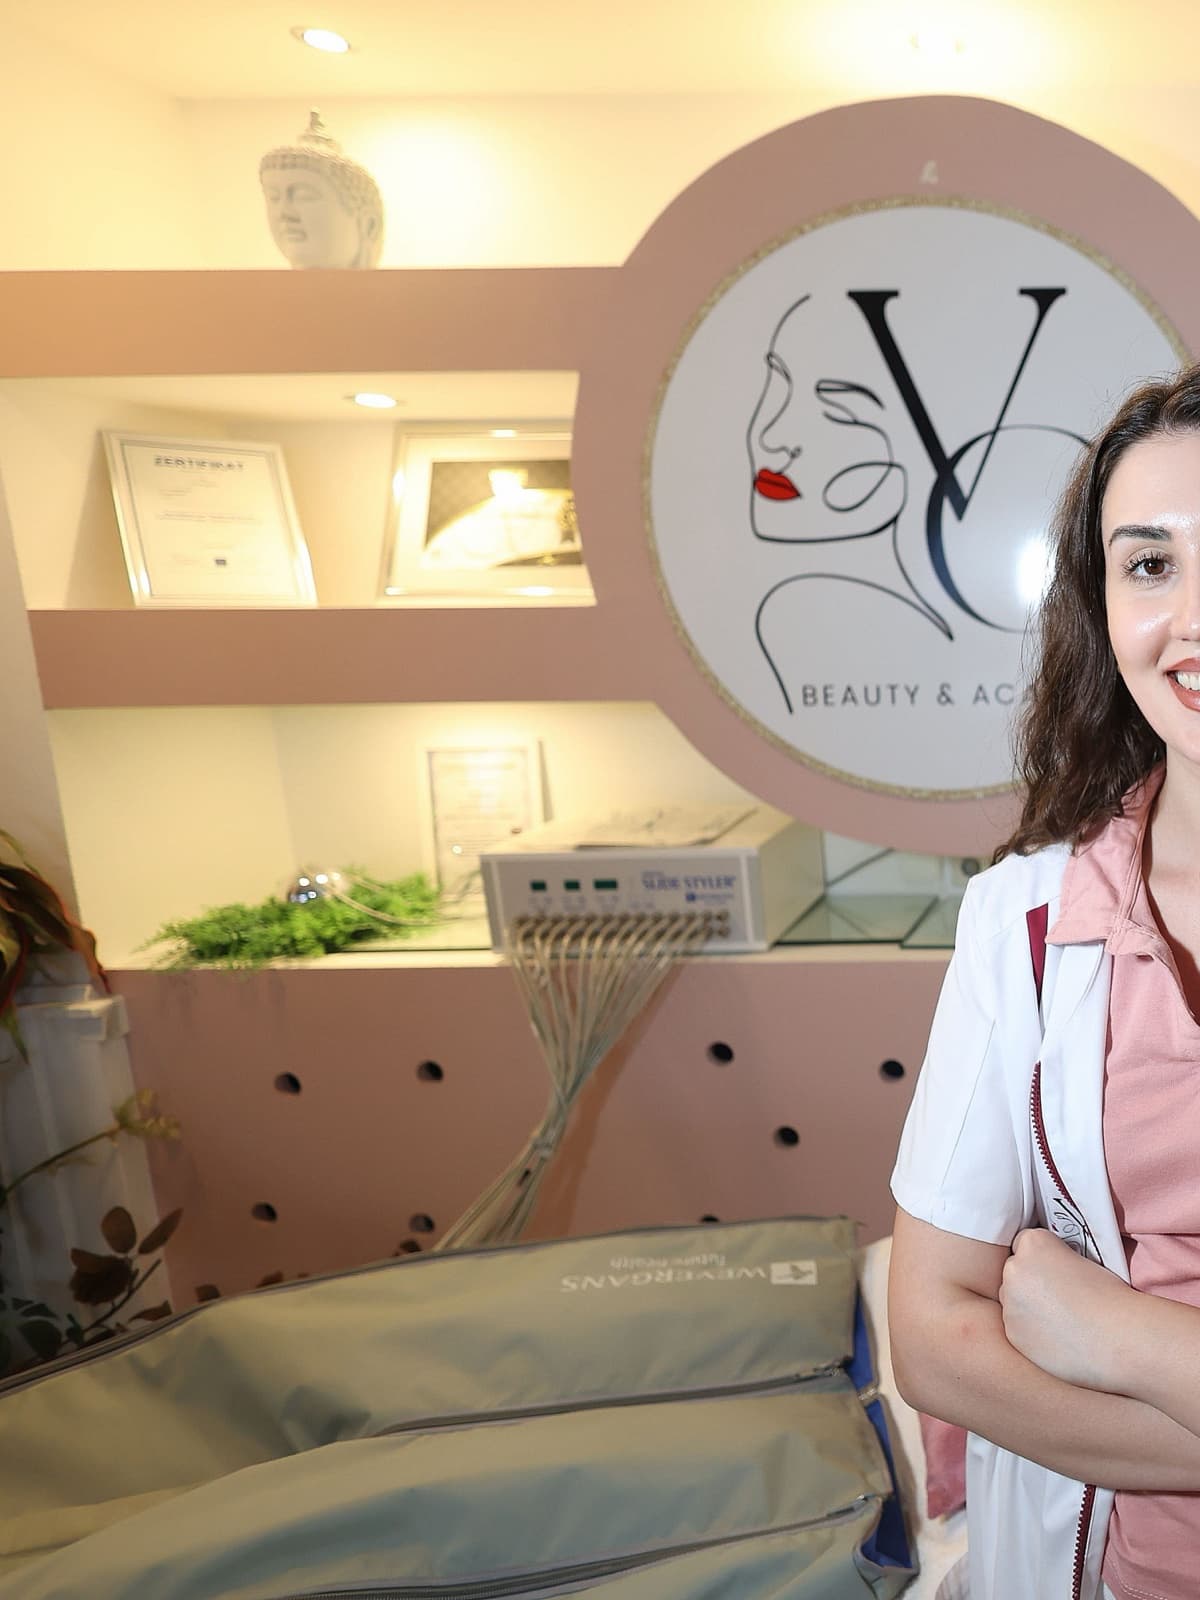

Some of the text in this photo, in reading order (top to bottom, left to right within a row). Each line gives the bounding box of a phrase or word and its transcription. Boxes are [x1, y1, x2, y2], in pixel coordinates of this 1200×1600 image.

[802, 683, 920, 706] BEAUTY
[936, 683, 955, 706] &
[560, 1267, 767, 1292] WEYERGANS
